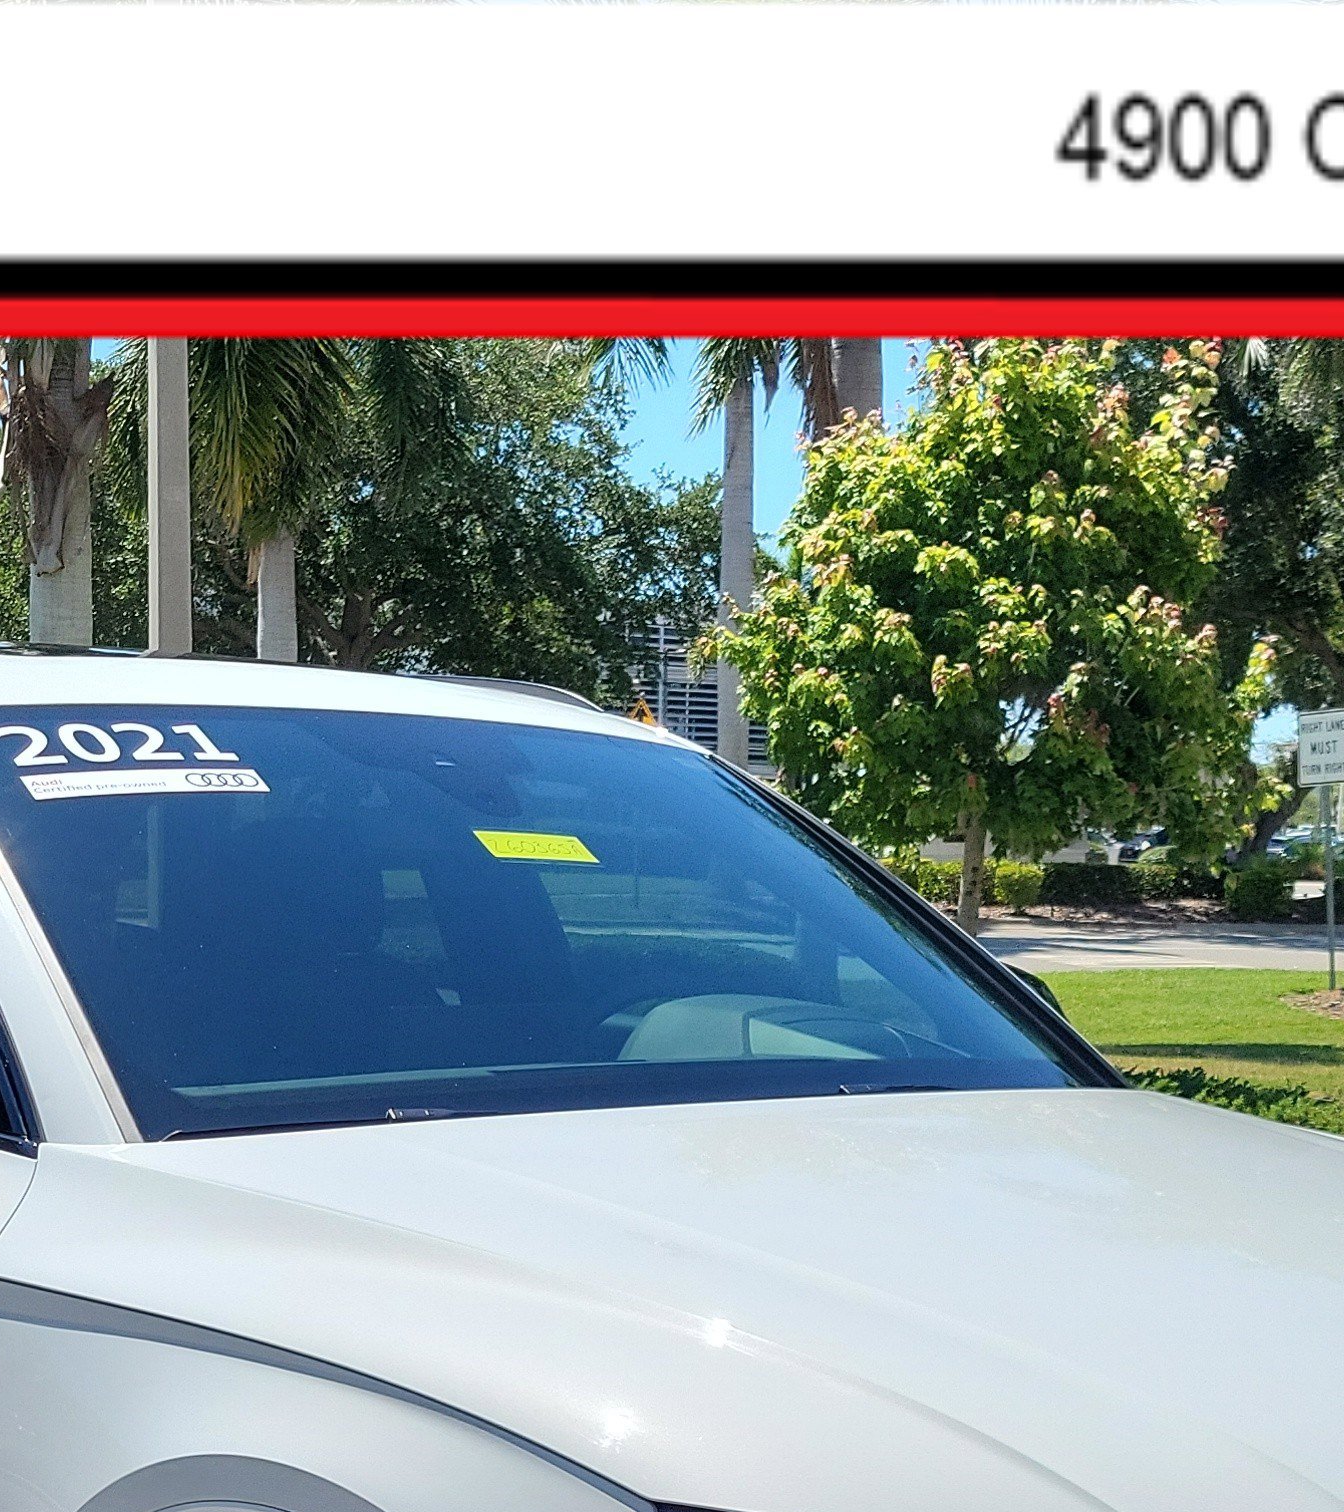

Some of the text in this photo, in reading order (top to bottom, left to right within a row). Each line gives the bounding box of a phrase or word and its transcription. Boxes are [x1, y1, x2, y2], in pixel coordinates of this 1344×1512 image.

[1309, 740, 1337, 755] MUST
[31, 778, 63, 788] Audi
[33, 780, 168, 794] Certified pre-owned
